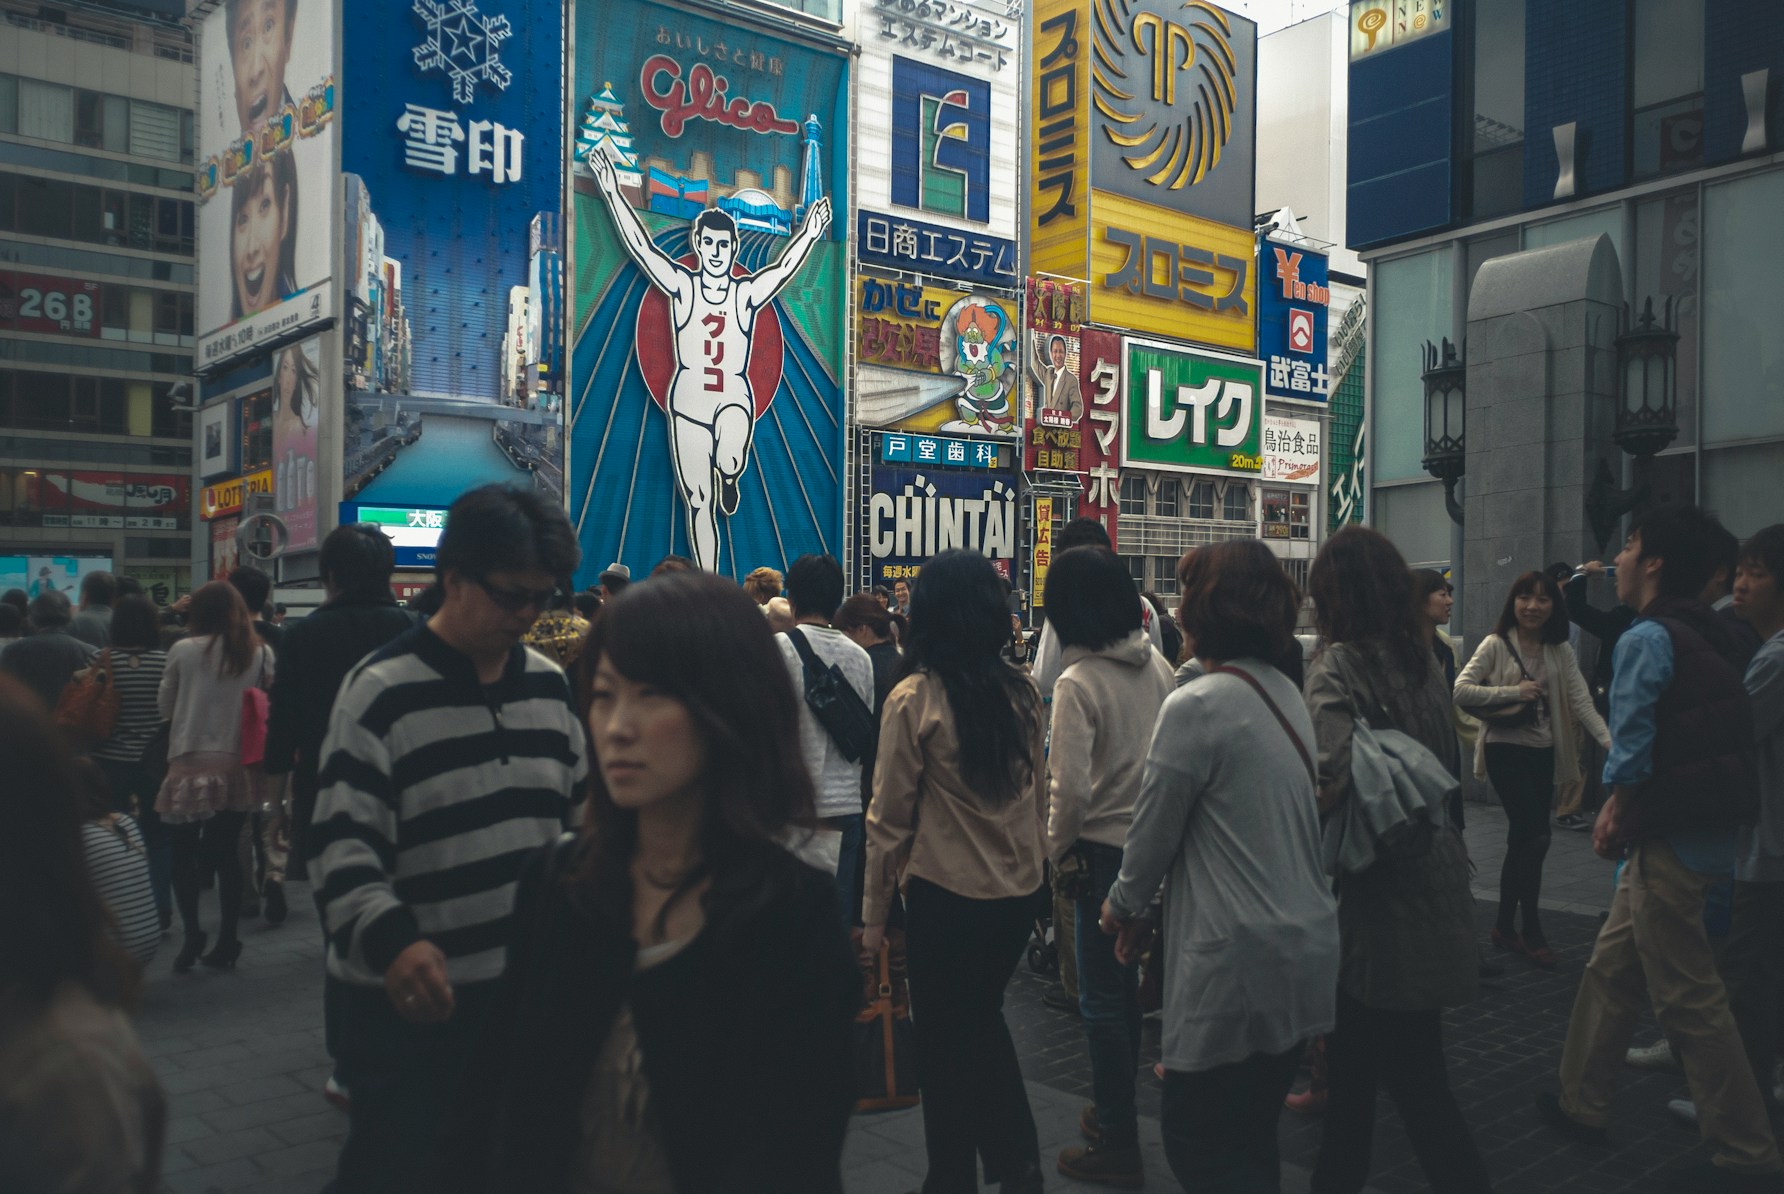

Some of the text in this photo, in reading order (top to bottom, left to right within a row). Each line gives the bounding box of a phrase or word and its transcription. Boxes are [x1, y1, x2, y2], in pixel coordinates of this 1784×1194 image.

[656, 25, 783, 76] おいしさと健康
[881, 15, 1007, 72] エステムコート
[641, 54, 799, 138] Glico
[1037, 8, 1079, 227] プロミス
[396, 102, 525, 183] 雪印
[867, 218, 1016, 276] 日商エステム
[1105, 226, 1248, 317] プロミス
[19, 287, 94, 321] 268
[862, 278, 941, 321] かぜに
[1307, 281, 1330, 307] shop
[701, 311, 727, 392] グリコ
[1270, 355, 1329, 394] 武富士
[1146, 368, 1253, 446] レイク
[888, 436, 992, 463] 戸堂歯科
[1033, 426, 1082, 449] 食べ放題
[1038, 450, 1077, 470] 自助餐
[1232, 454, 1254, 469] 20m
[217, 477, 269, 508] LOTTRIA
[870, 475, 1015, 558] CHINTAI
[408, 509, 443, 528] 大阪
[1035, 504, 1051, 566] 貸広告
